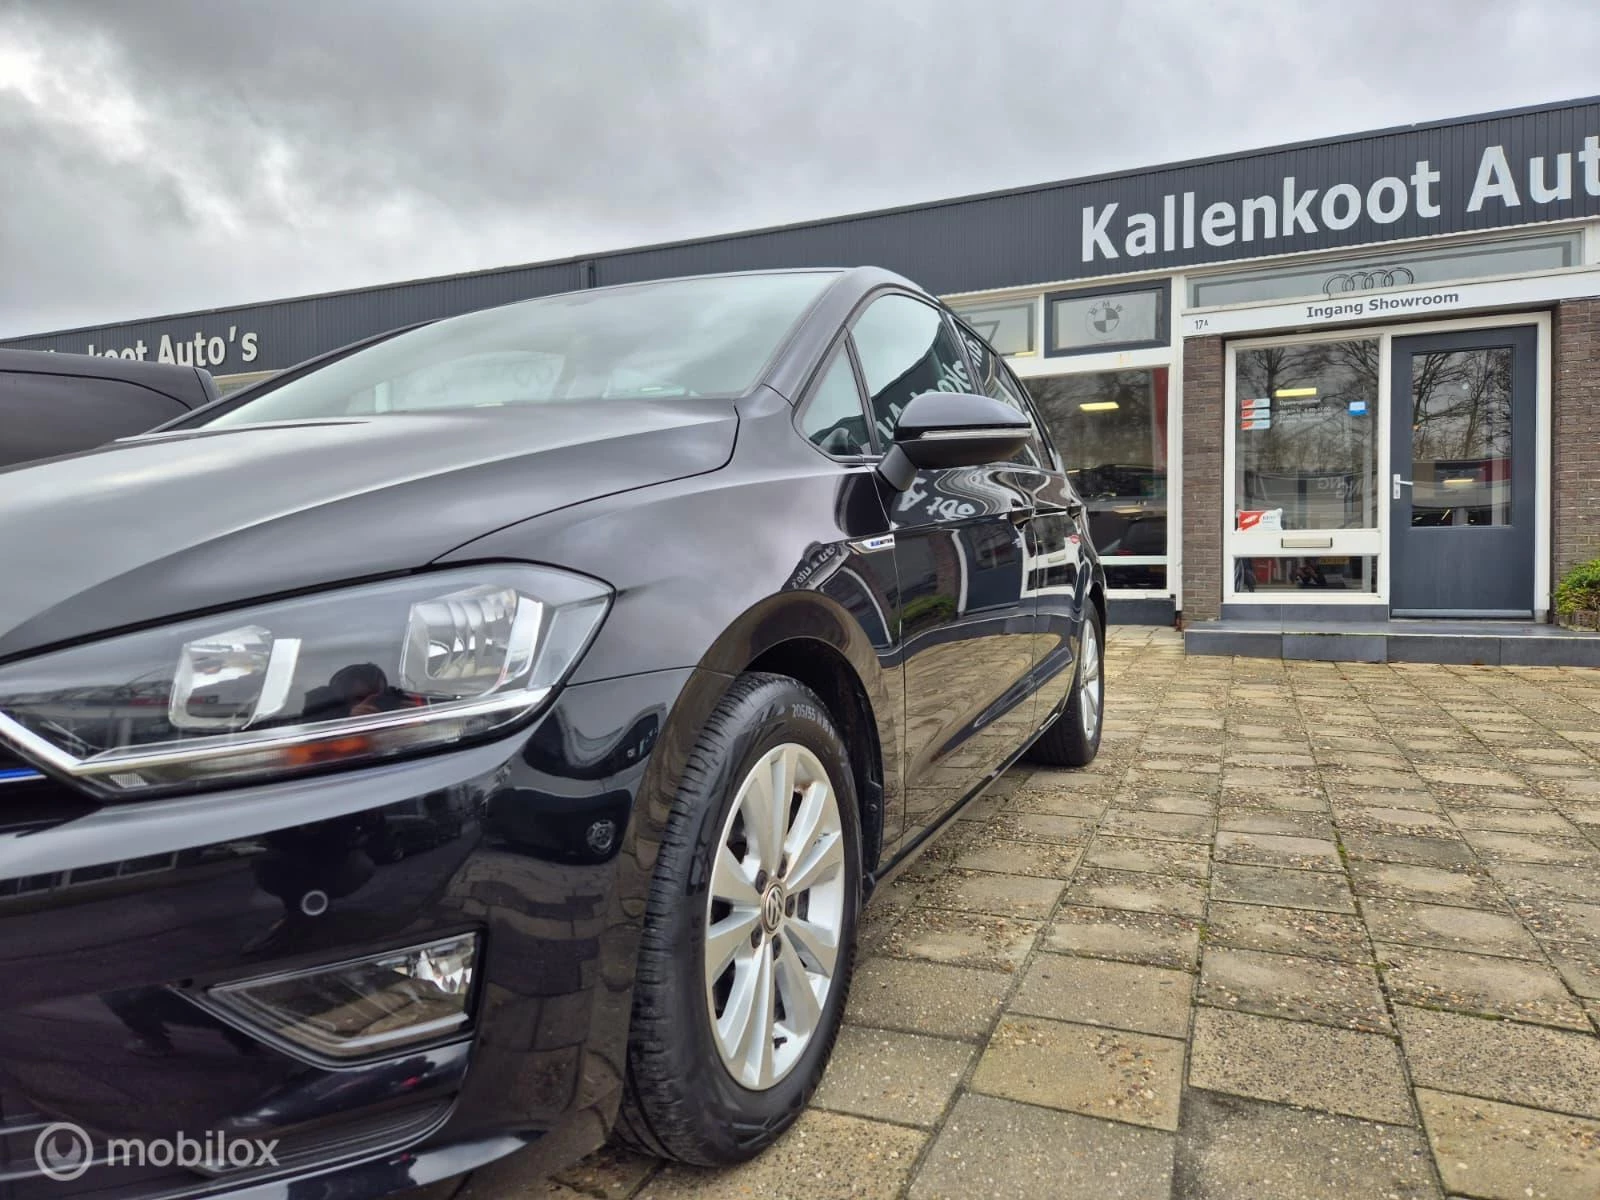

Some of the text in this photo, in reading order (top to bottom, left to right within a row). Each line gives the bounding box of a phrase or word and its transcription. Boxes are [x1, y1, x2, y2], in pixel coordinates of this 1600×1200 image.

[1082, 161, 1441, 262] Kallenkoot
[1306, 293, 1460, 319] Ingang Showroom
[157, 326, 259, 367] Auto's
